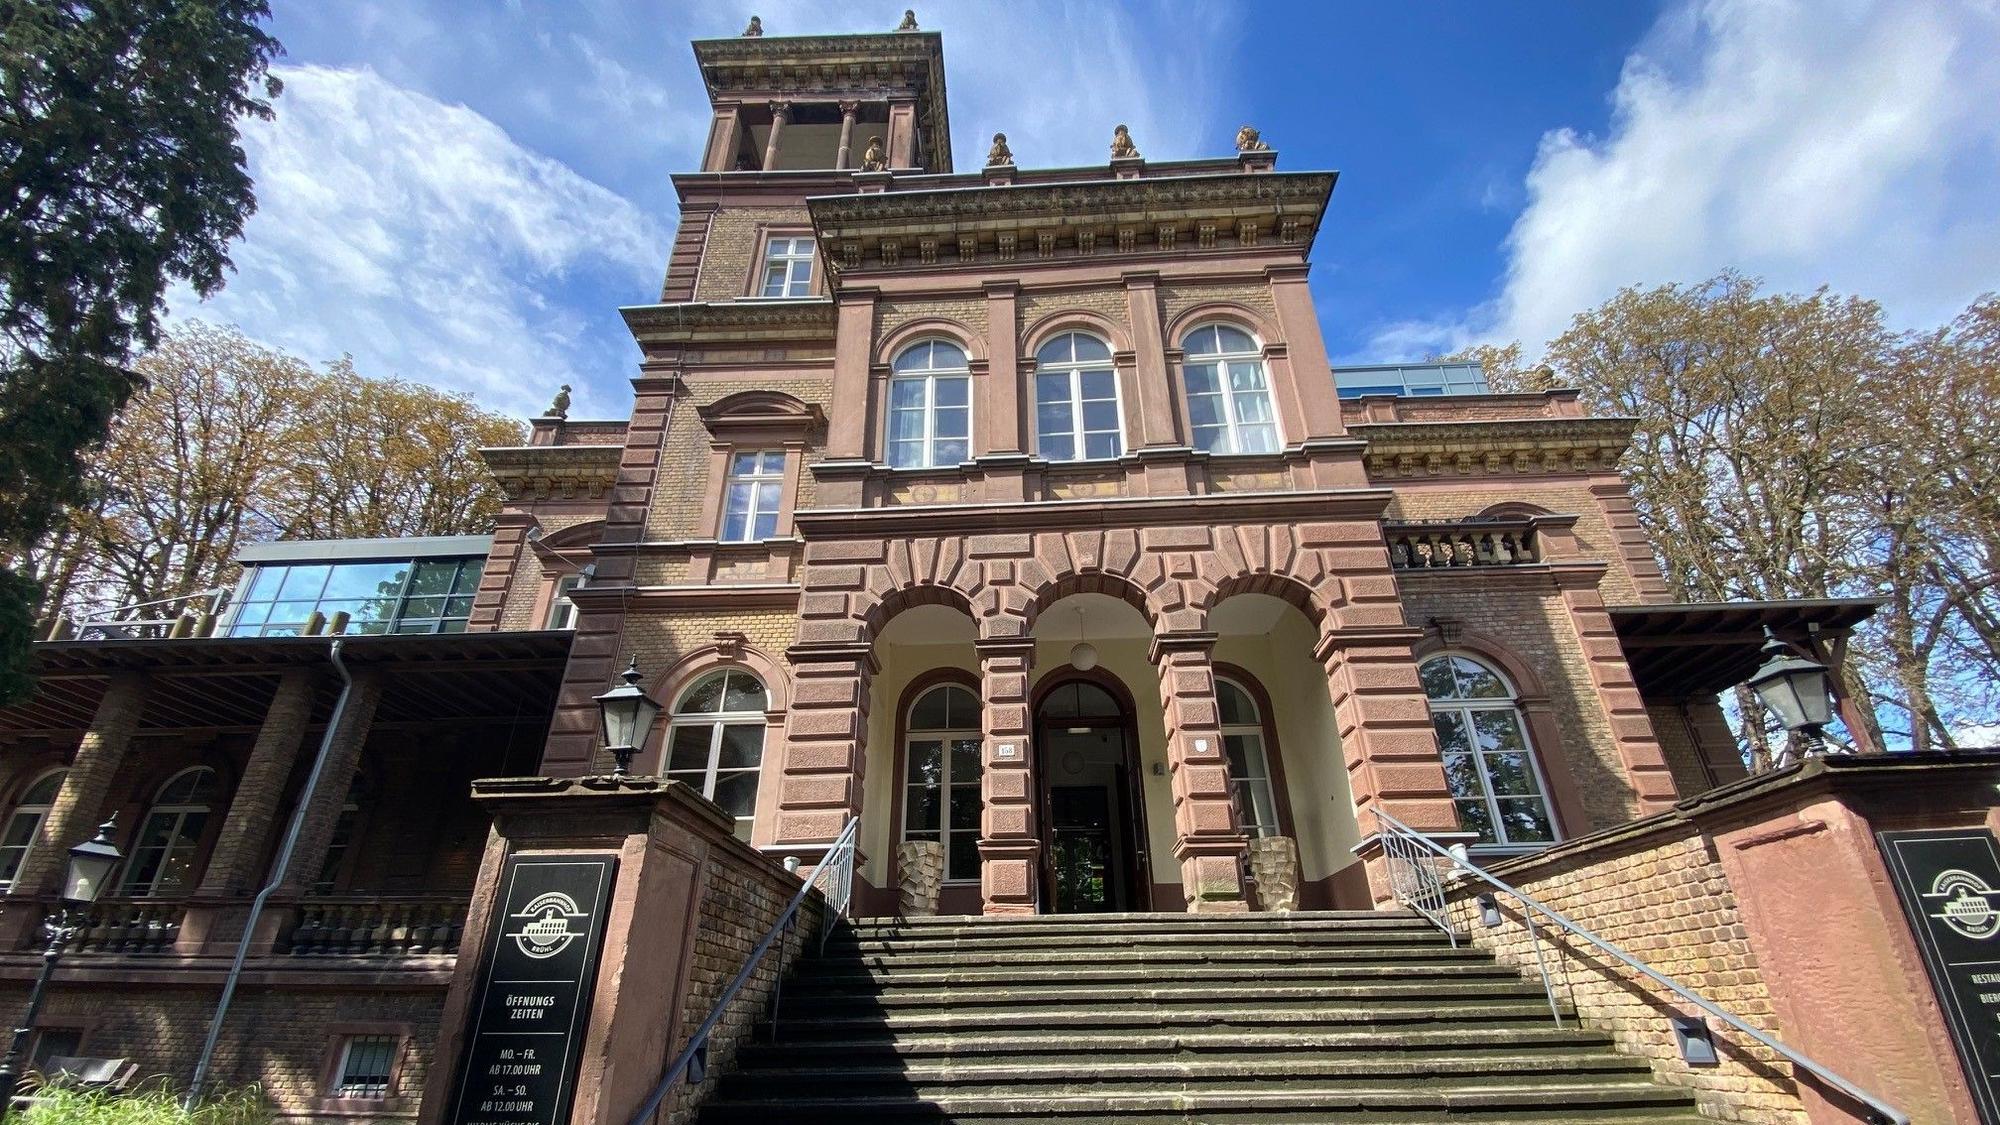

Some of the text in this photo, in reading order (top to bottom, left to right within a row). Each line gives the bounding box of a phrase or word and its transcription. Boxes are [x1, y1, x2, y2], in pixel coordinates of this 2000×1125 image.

[530, 897, 572, 912] KAISERBAHNHOF
[531, 945, 553, 953] BRÜHL
[505, 994, 555, 1007] ÖFFNUNGS
[510, 1008, 544, 1019] ZEITEN
[500, 1049, 515, 1059] MO.
[523, 1049, 536, 1059] FR.
[489, 1064, 542, 1075] AB 17.00 UHR
[493, 1085, 506, 1096] SA.
[514, 1085, 527, 1096] SO.
[480, 1101, 534, 1112] AB 12.00 UHR
